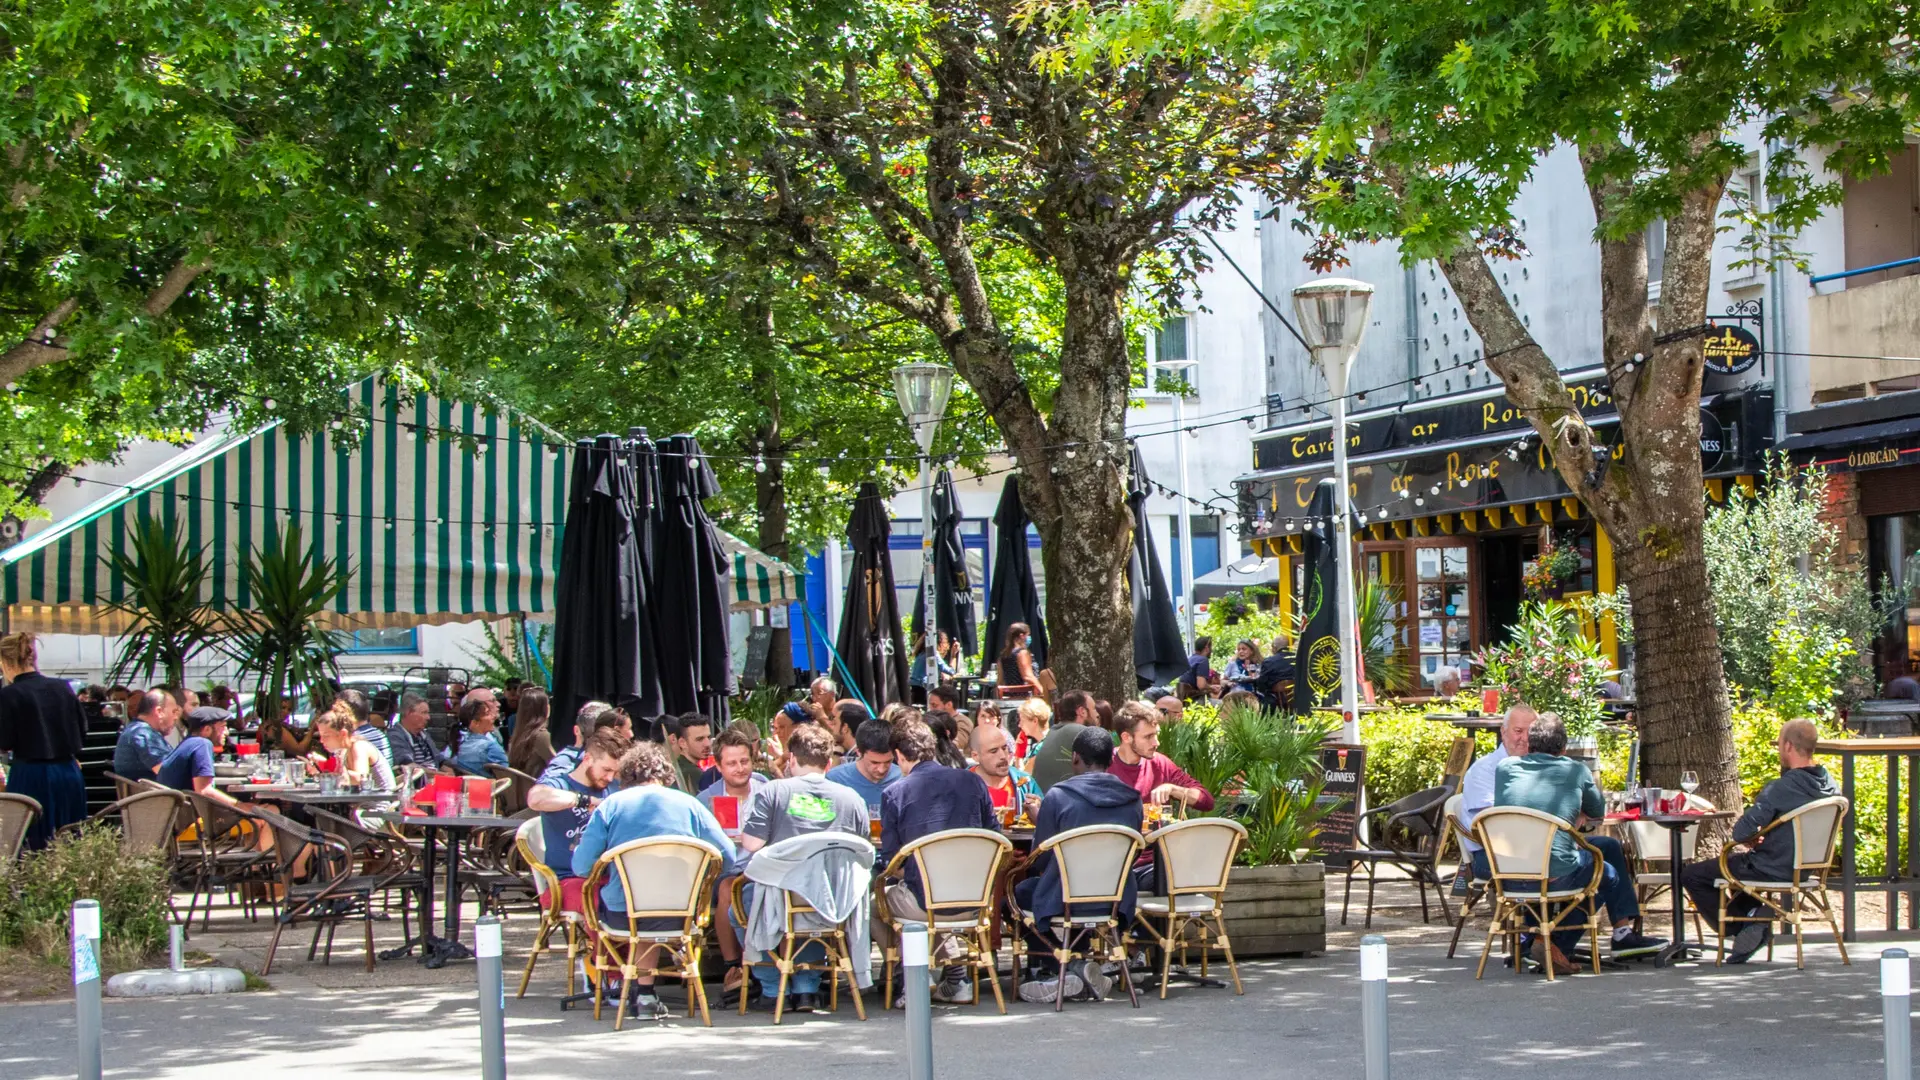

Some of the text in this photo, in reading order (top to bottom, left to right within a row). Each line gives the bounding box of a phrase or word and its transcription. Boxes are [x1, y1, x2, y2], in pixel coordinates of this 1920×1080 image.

[1411, 421, 1439, 437] ar
[1699, 439, 1720, 452] NESS
[1848, 446, 1899, 467] Ó LORCÁIN
[1391, 473, 1414, 492] ar
[1325, 769, 1356, 782] GUINNESS
